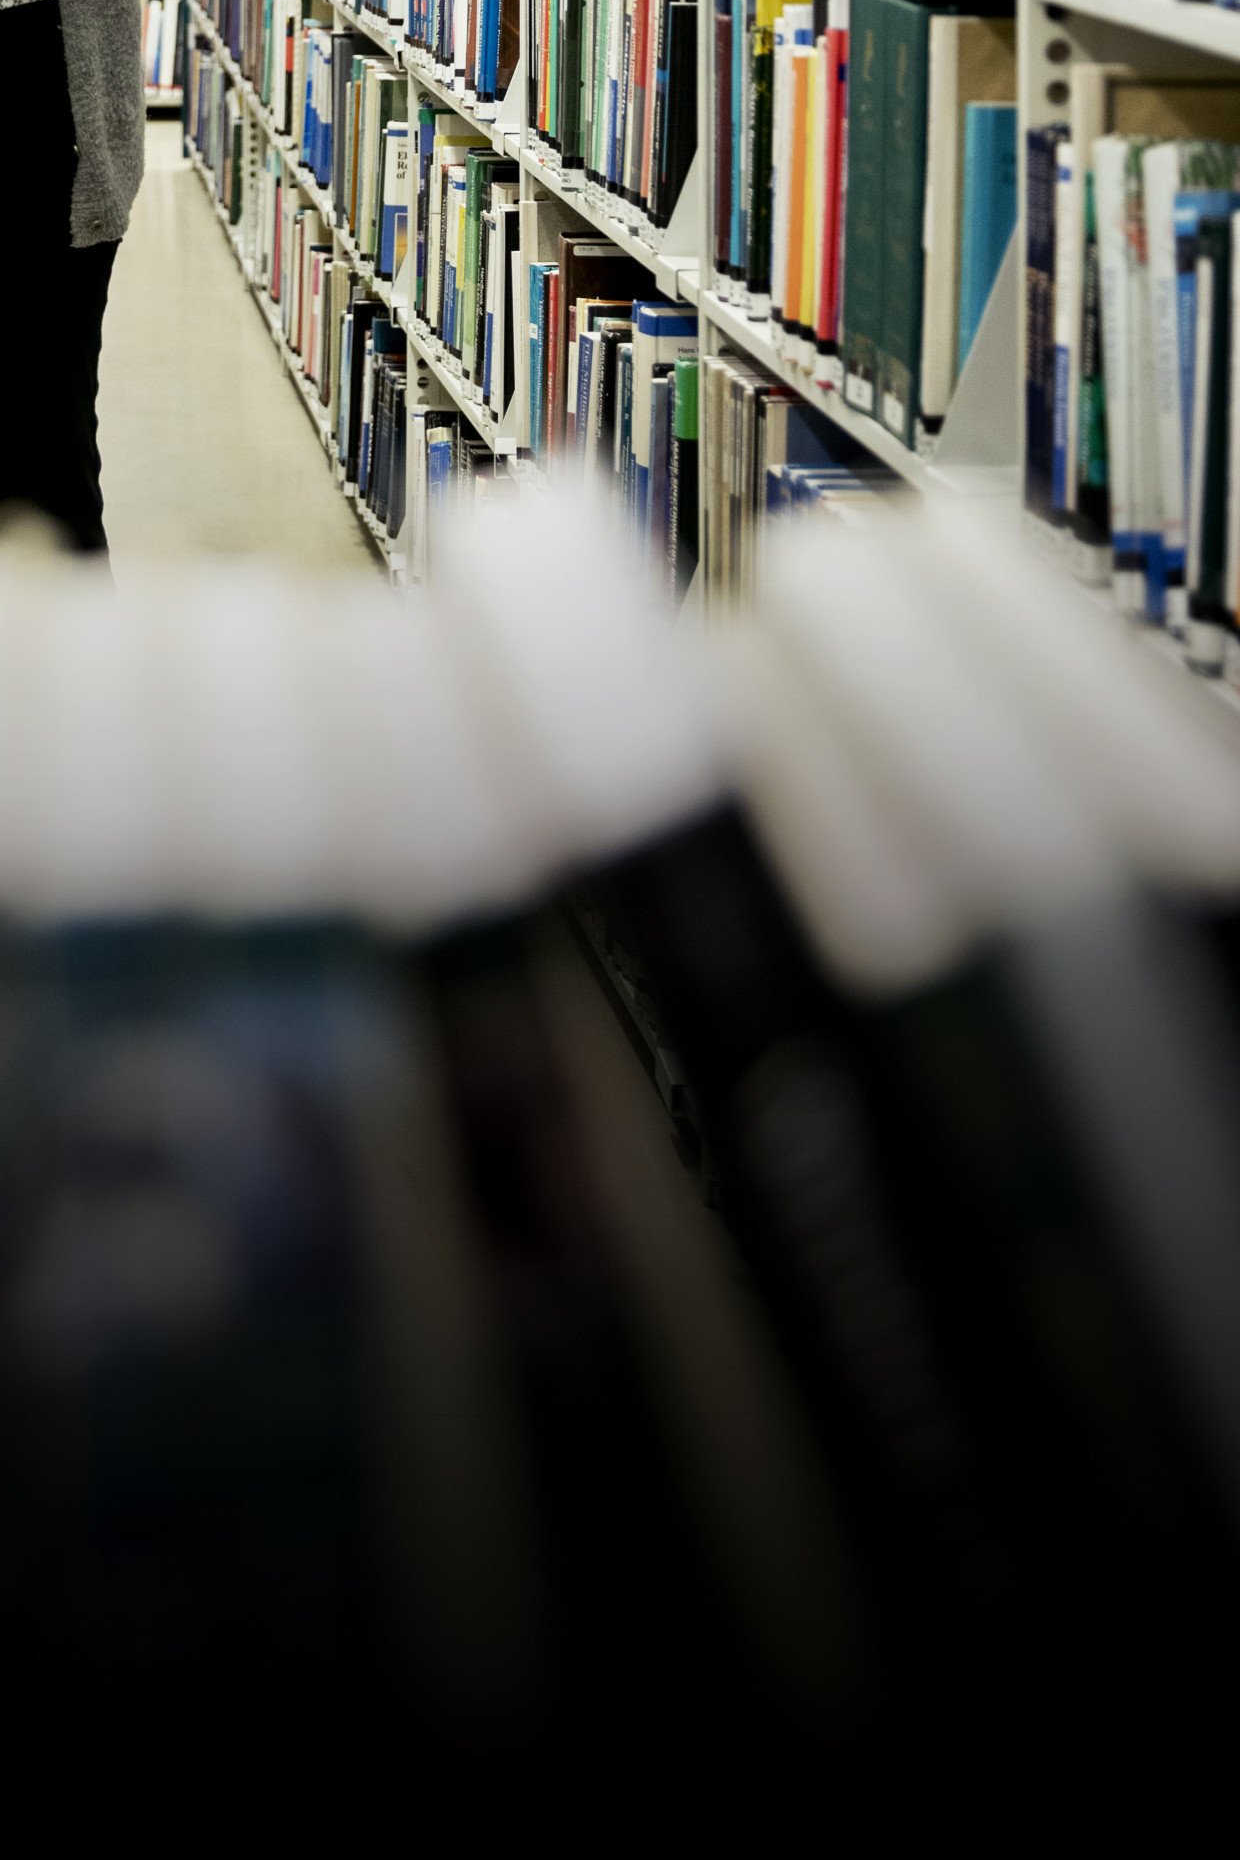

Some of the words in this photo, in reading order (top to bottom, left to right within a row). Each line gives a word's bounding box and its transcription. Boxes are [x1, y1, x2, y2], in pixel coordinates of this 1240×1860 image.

[621, 21, 631, 116] Lactoferrin
[396, 171, 406, 179] of
[677, 346, 695, 354] Hans
[581, 370, 589, 427] Maillard
[597, 427, 603, 438] IN
[671, 478, 679, 564] SPECTROMETRY
